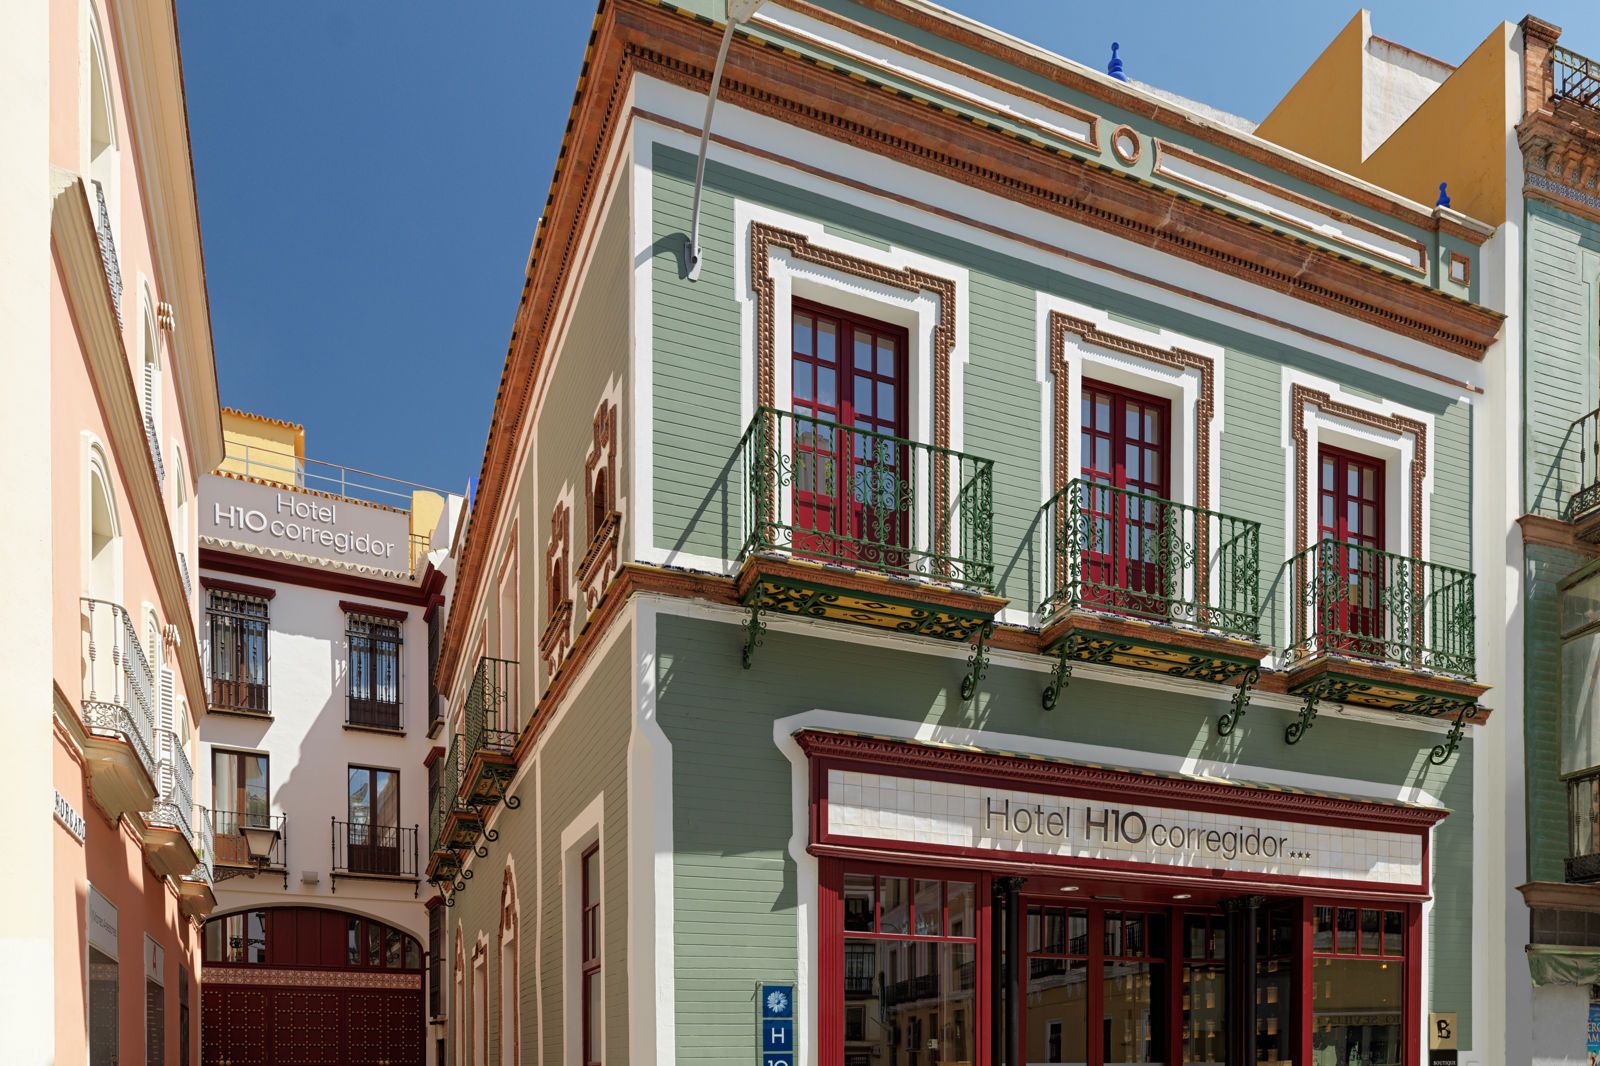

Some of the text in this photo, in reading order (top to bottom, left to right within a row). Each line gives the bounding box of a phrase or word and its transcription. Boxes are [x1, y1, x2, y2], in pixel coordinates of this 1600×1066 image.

[277, 493, 336, 524] Hotel
[214, 502, 395, 558] H10 corregidor
[986, 796, 1288, 860] Hotel H10 corregidor
[771, 1027, 785, 1044] H
[1436, 1019, 1451, 1039] B
